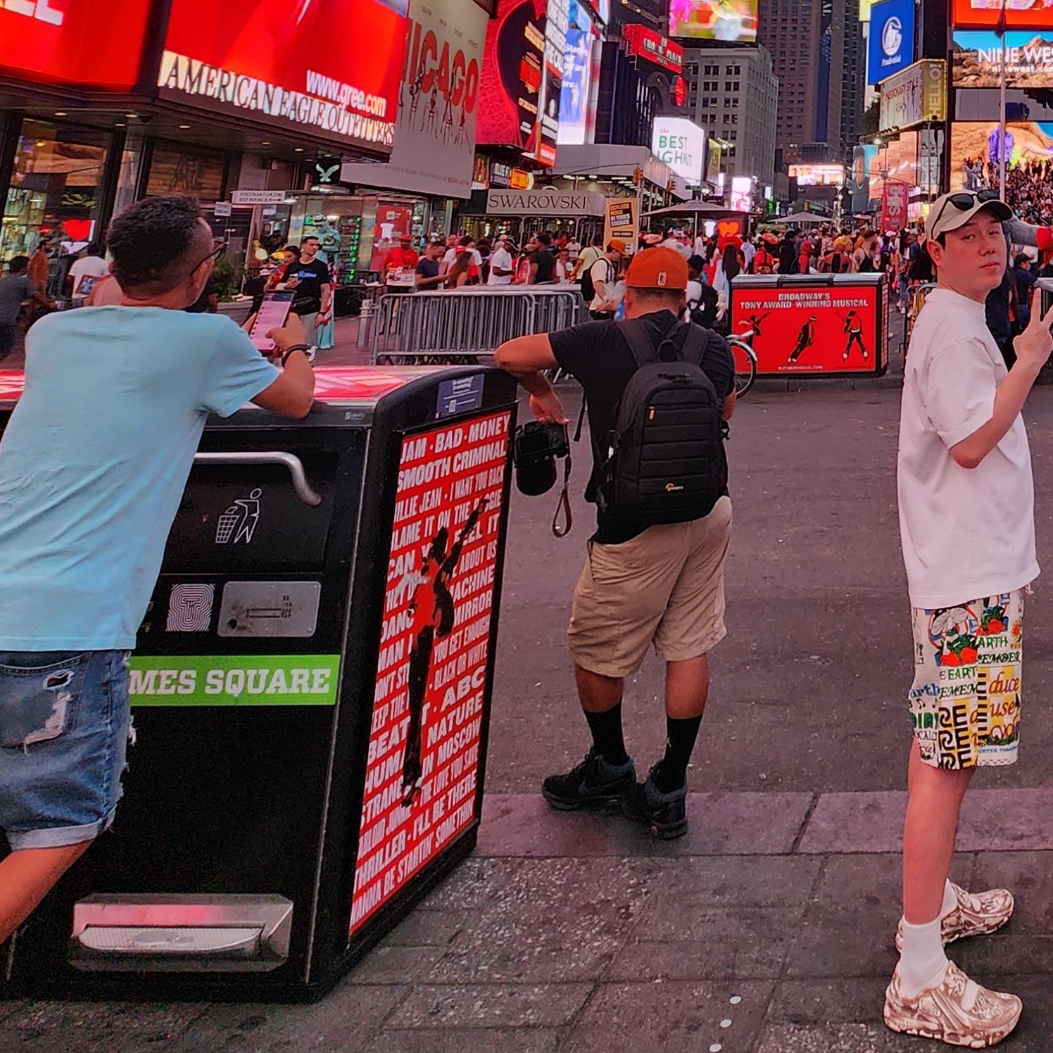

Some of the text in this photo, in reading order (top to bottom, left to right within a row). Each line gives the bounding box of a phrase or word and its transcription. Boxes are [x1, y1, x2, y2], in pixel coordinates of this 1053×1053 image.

[978, 47, 1019, 63] NINE
[166, 54, 273, 115] AMERICAN
[279, 88, 325, 127] EAGLE
[306, 68, 387, 118] www.gree.com
[928, 63, 942, 119] HELLO!
[658, 135, 687, 150] BEST
[488, 194, 586, 210] SWAROVSKI
[740, 299, 868, 309] TONY MUSICAL
[778, 292, 830, 301] BROADWAY'S
[400, 413, 511, 465] JAM BAD MONEY
[396, 439, 506, 493] SMOOTH CRIMINAL
[419, 486, 442, 513] JEAN
[454, 475, 474, 500] WANT
[475, 469, 488, 492] YOU
[424, 501, 471, 538] IT THE
[487, 513, 500, 535] IT
[458, 546, 486, 575] ABOUT
[486, 539, 497, 561] US
[453, 589, 493, 628] MIRROR
[433, 629, 464, 665] YOU GET
[205, 668, 331, 697] SQUARE
[367, 714, 411, 766] BEAT
[440, 665, 486, 713] ABC
[390, 691, 406, 721] THE
[426, 690, 484, 749] NATURE
[421, 715, 482, 779] IN MOSCOW
[353, 769, 477, 895] THRILLER I'LL BE THERE
[383, 865, 396, 896] BE
